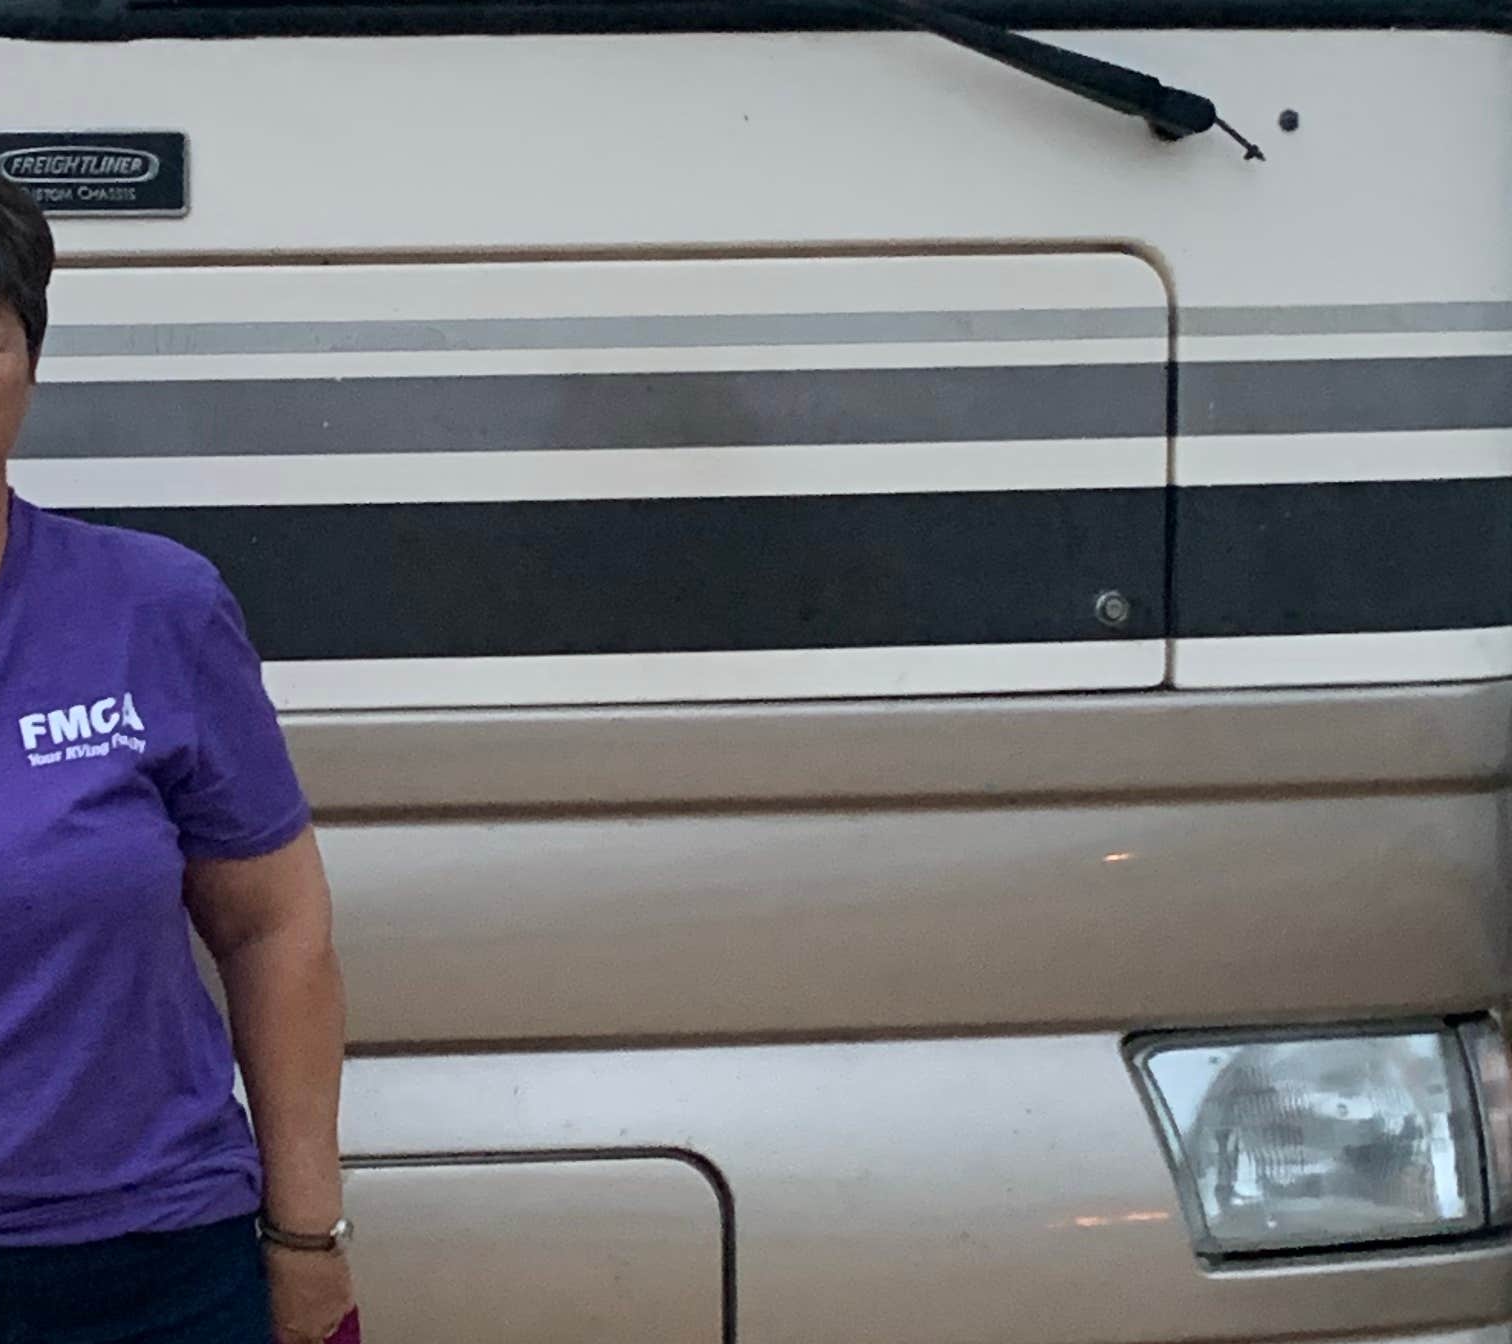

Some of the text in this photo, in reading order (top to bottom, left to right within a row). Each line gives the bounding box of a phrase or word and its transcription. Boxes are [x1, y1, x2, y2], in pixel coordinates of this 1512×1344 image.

[10, 155, 144, 175] FREIGHTLINER
[18, 691, 145, 750] FMCA
[27, 750, 63, 767] Your
